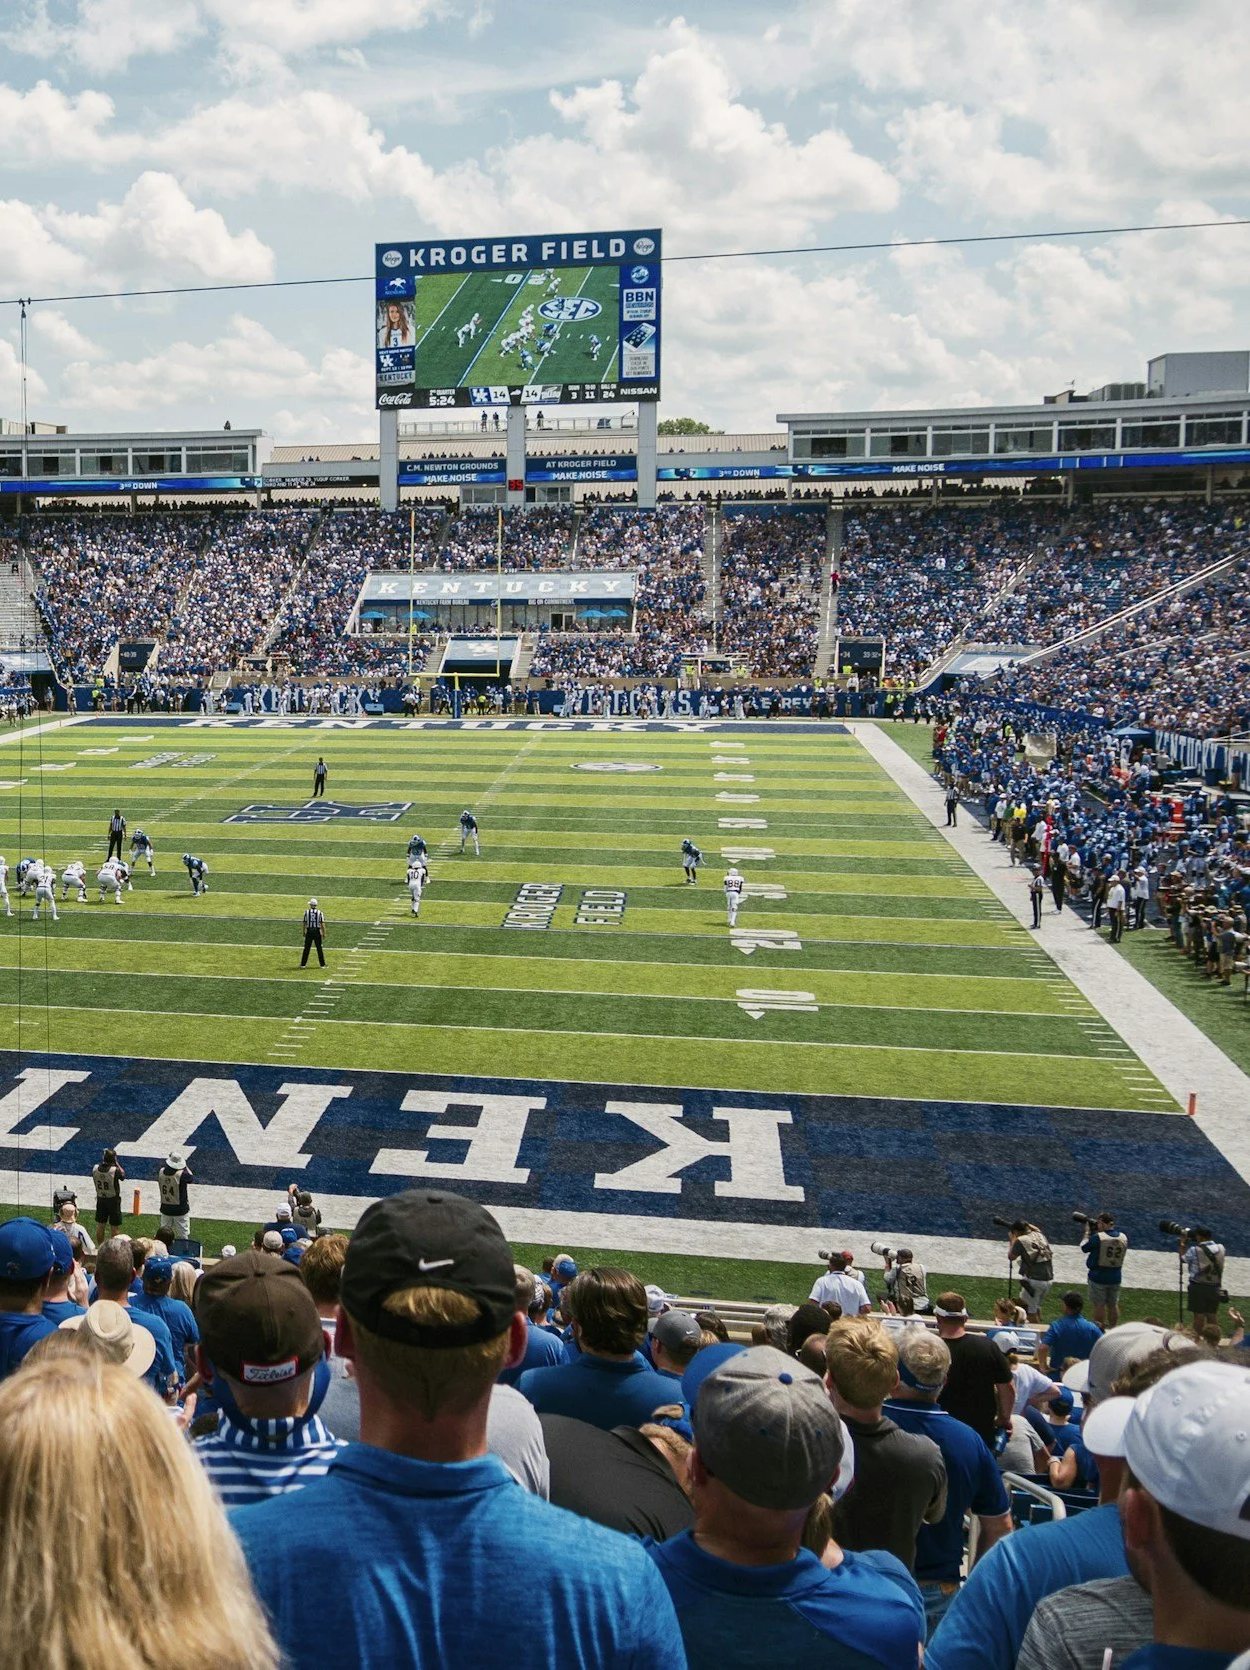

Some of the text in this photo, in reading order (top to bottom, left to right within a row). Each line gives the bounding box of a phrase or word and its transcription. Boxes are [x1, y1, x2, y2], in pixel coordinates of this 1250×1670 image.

[409, 238, 626, 268] KROGER FIELD
[625, 291, 654, 303] BBN
[493, 390, 506, 399] 14
[525, 390, 538, 398] 14
[585, 391, 595, 399] 11
[603, 391, 615, 399] 24
[620, 387, 657, 395] NISSAN
[429, 396, 456, 406] 5:24
[406, 462, 499, 472] C.M. NEWTON GROUNDS
[558, 460, 592, 469] KROGER
[593, 459, 617, 467] FIELD
[892, 463, 945, 473] MAKE NOISE
[424, 473, 477, 483] MAKE NOISE
[553, 471, 608, 480] MAKE NOISE
[133, 482, 158, 490] DOWN
[509, 480, 523, 491] 35
[377, 580, 620, 594] KENTUCKY
[178, 719, 723, 733] KENTUCKY
[410, 870, 420, 880] 10
[728, 878, 740, 888] 88
[500, 883, 627, 929] KROGER FIELD
[309, 913, 317, 923] R
[97, 1181, 109, 1191] 28
[162, 1185, 174, 1196] 64
[1106, 1246, 1121, 1258] 62
[246, 1367, 293, 1380] Titleist
